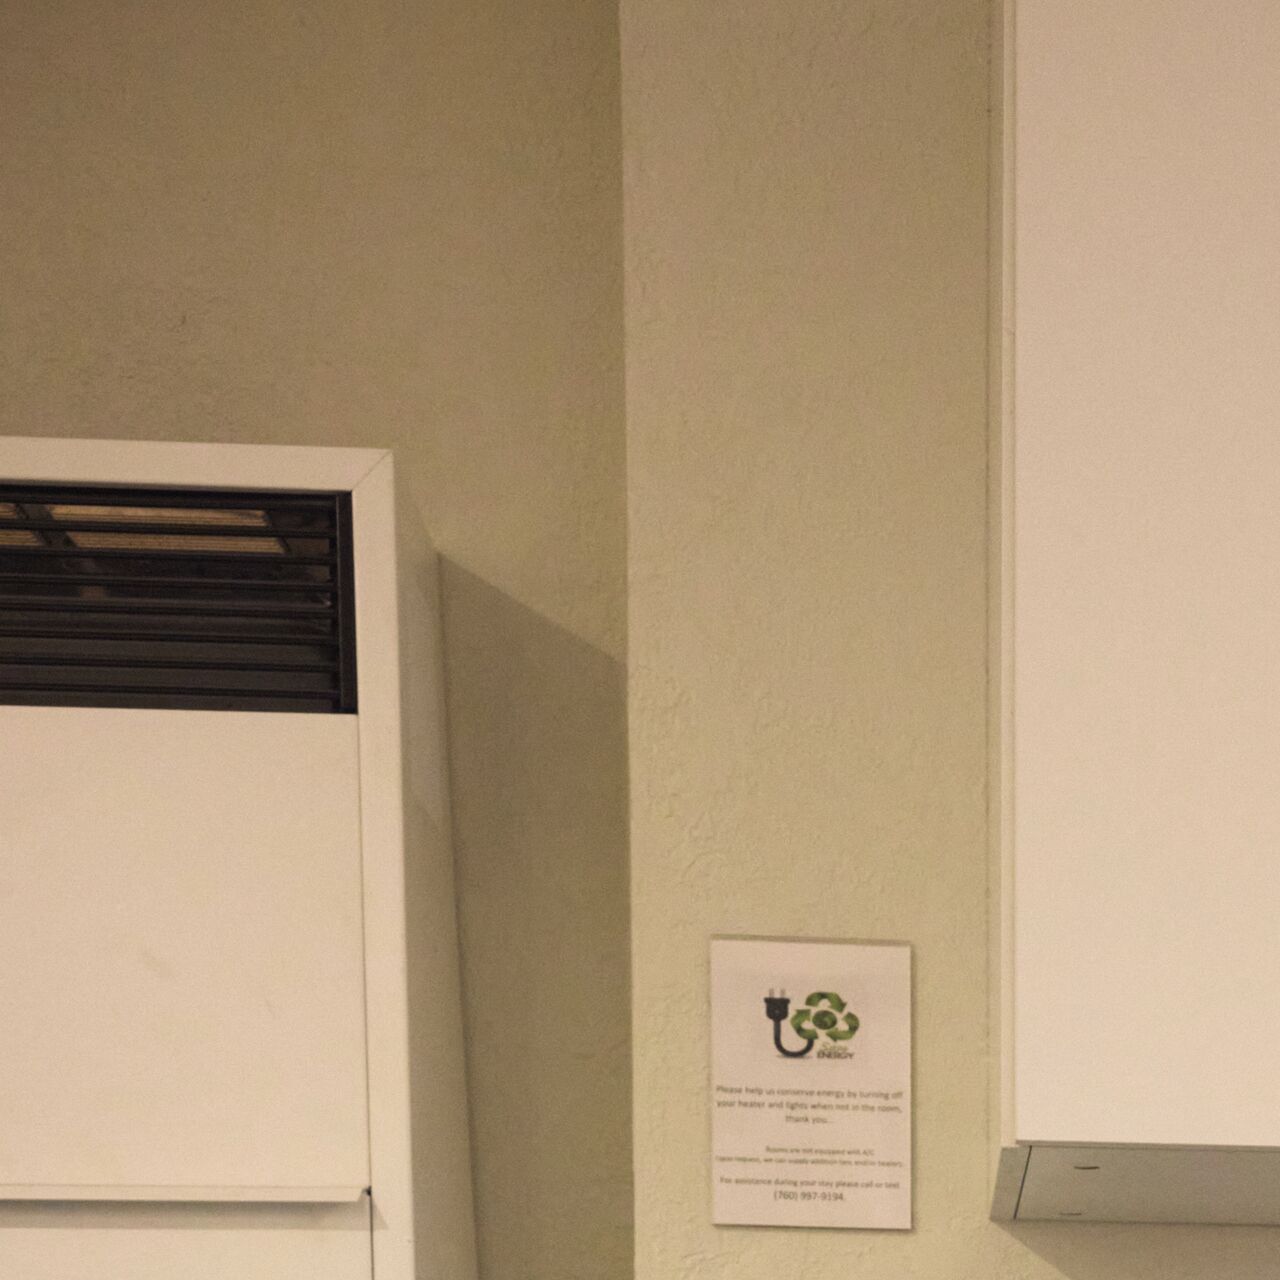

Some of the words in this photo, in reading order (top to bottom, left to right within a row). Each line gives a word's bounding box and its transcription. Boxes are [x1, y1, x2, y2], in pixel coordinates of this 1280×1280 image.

[716, 1085, 742, 1094] Please
[745, 1085, 763, 1096] help
[777, 1088, 815, 1096] conserve
[816, 1090, 845, 1099] energy
[859, 1090, 889, 1100] turning
[738, 1099, 765, 1108] heater
